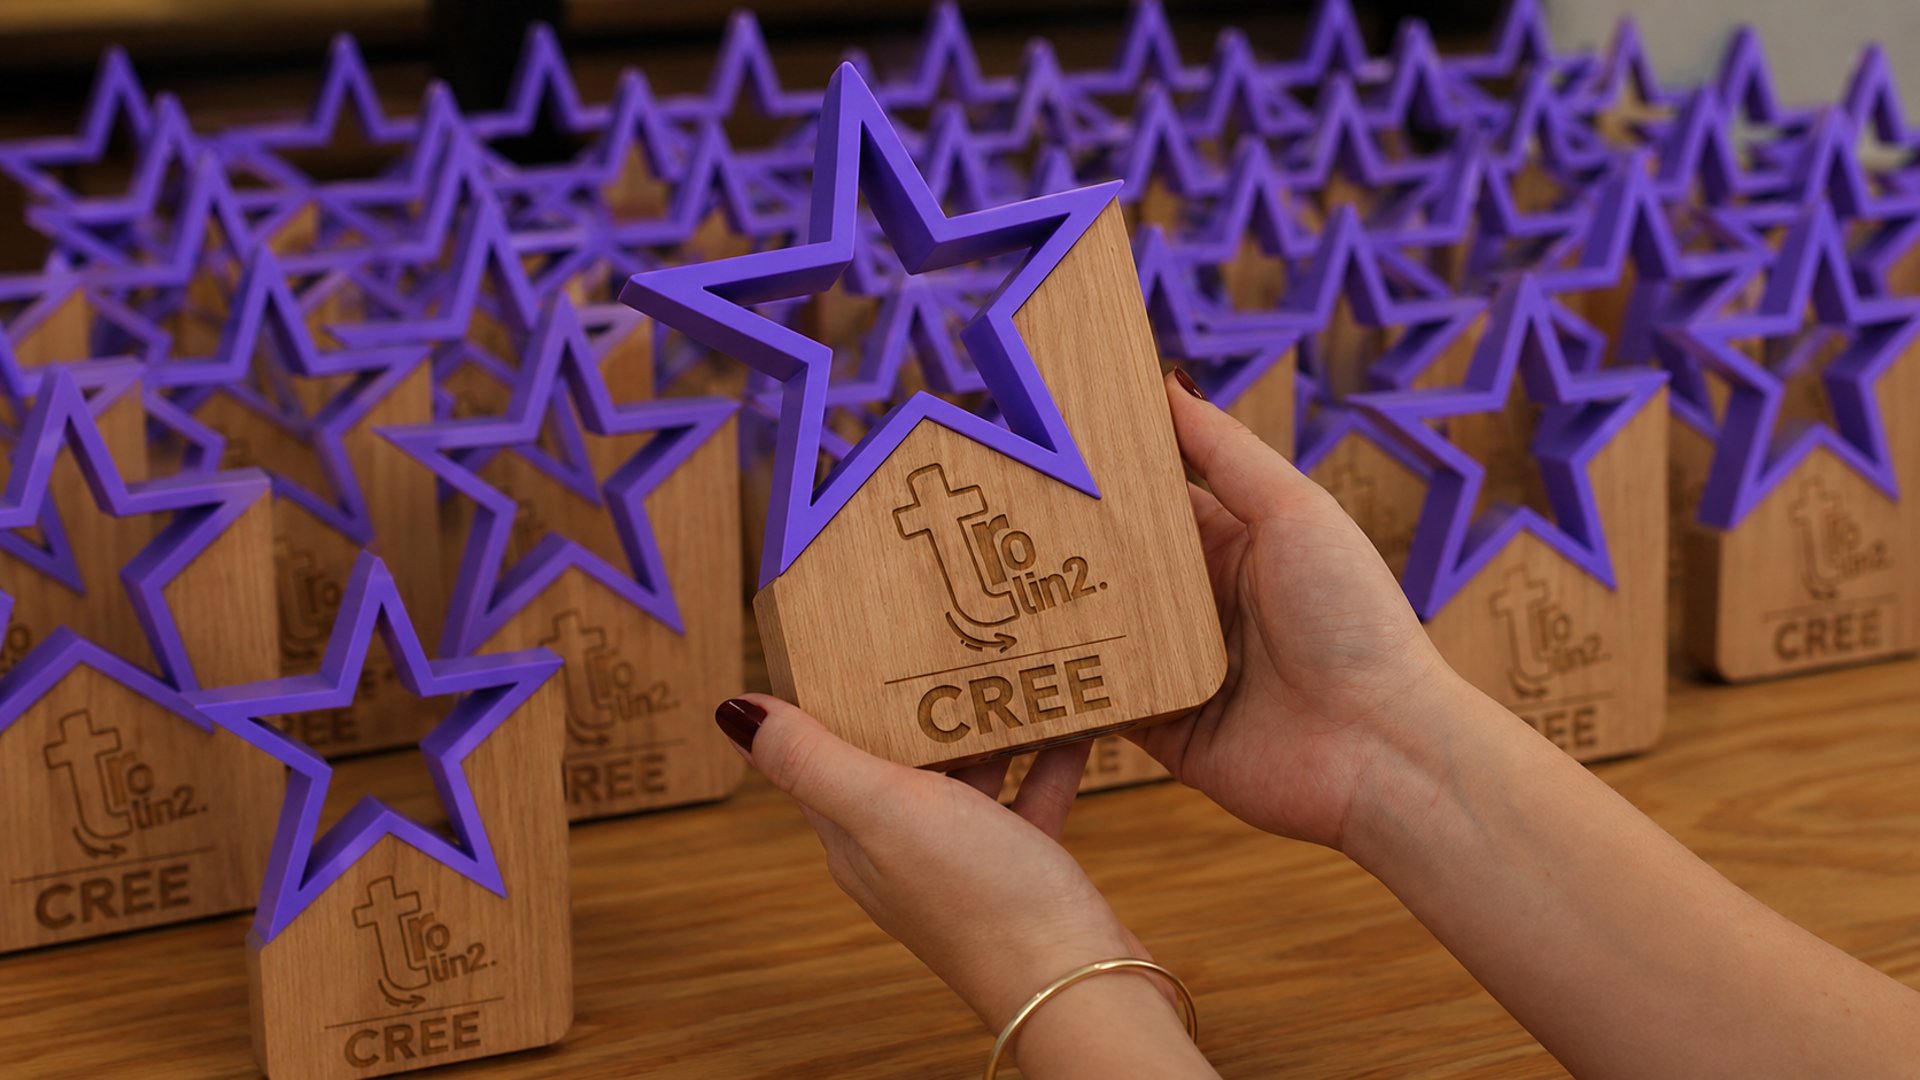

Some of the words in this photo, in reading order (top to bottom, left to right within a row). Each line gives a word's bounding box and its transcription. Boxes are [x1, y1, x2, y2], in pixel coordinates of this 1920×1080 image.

[1772, 607, 1882, 663] CREE
[916, 654, 1113, 745] CREE
[33, 862, 193, 931] CREE
[344, 1010, 482, 1069] CREE
